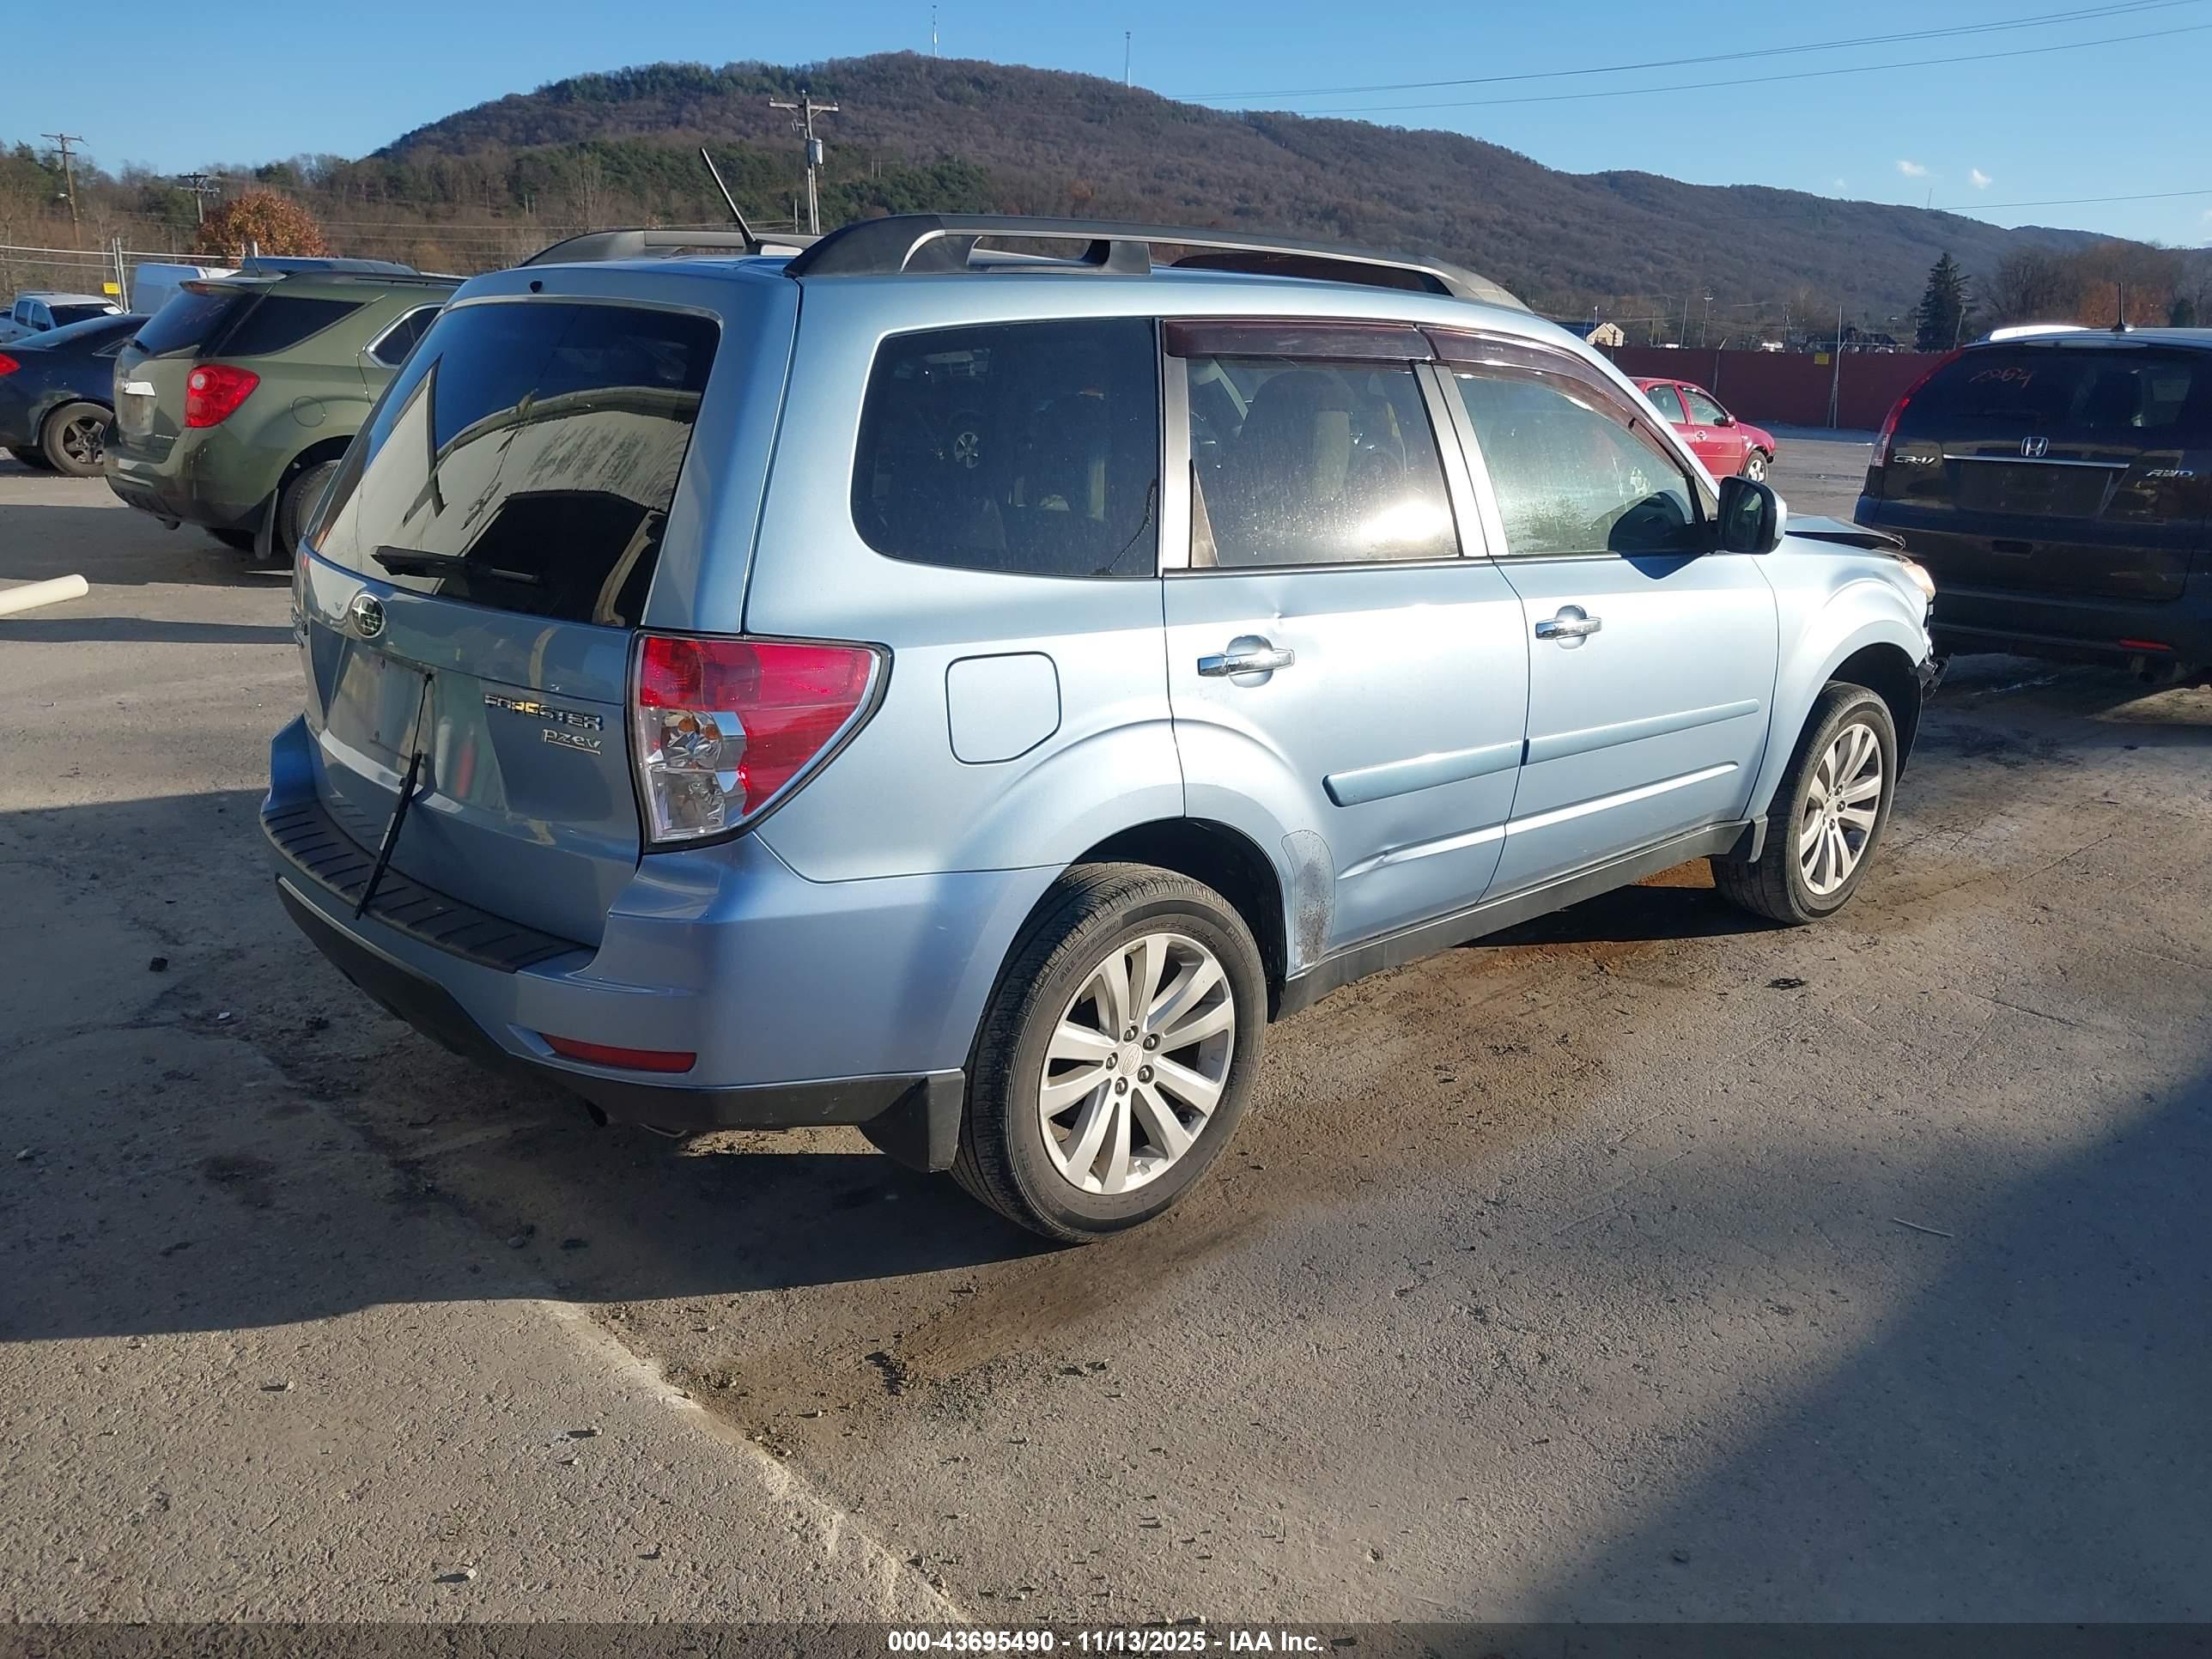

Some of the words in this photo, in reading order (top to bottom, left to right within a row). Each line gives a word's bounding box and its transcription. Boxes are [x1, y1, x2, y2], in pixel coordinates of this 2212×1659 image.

[1893, 454, 1936, 465] CR-V
[2145, 468, 2194, 478] AWD
[484, 694, 603, 731] FORESTER
